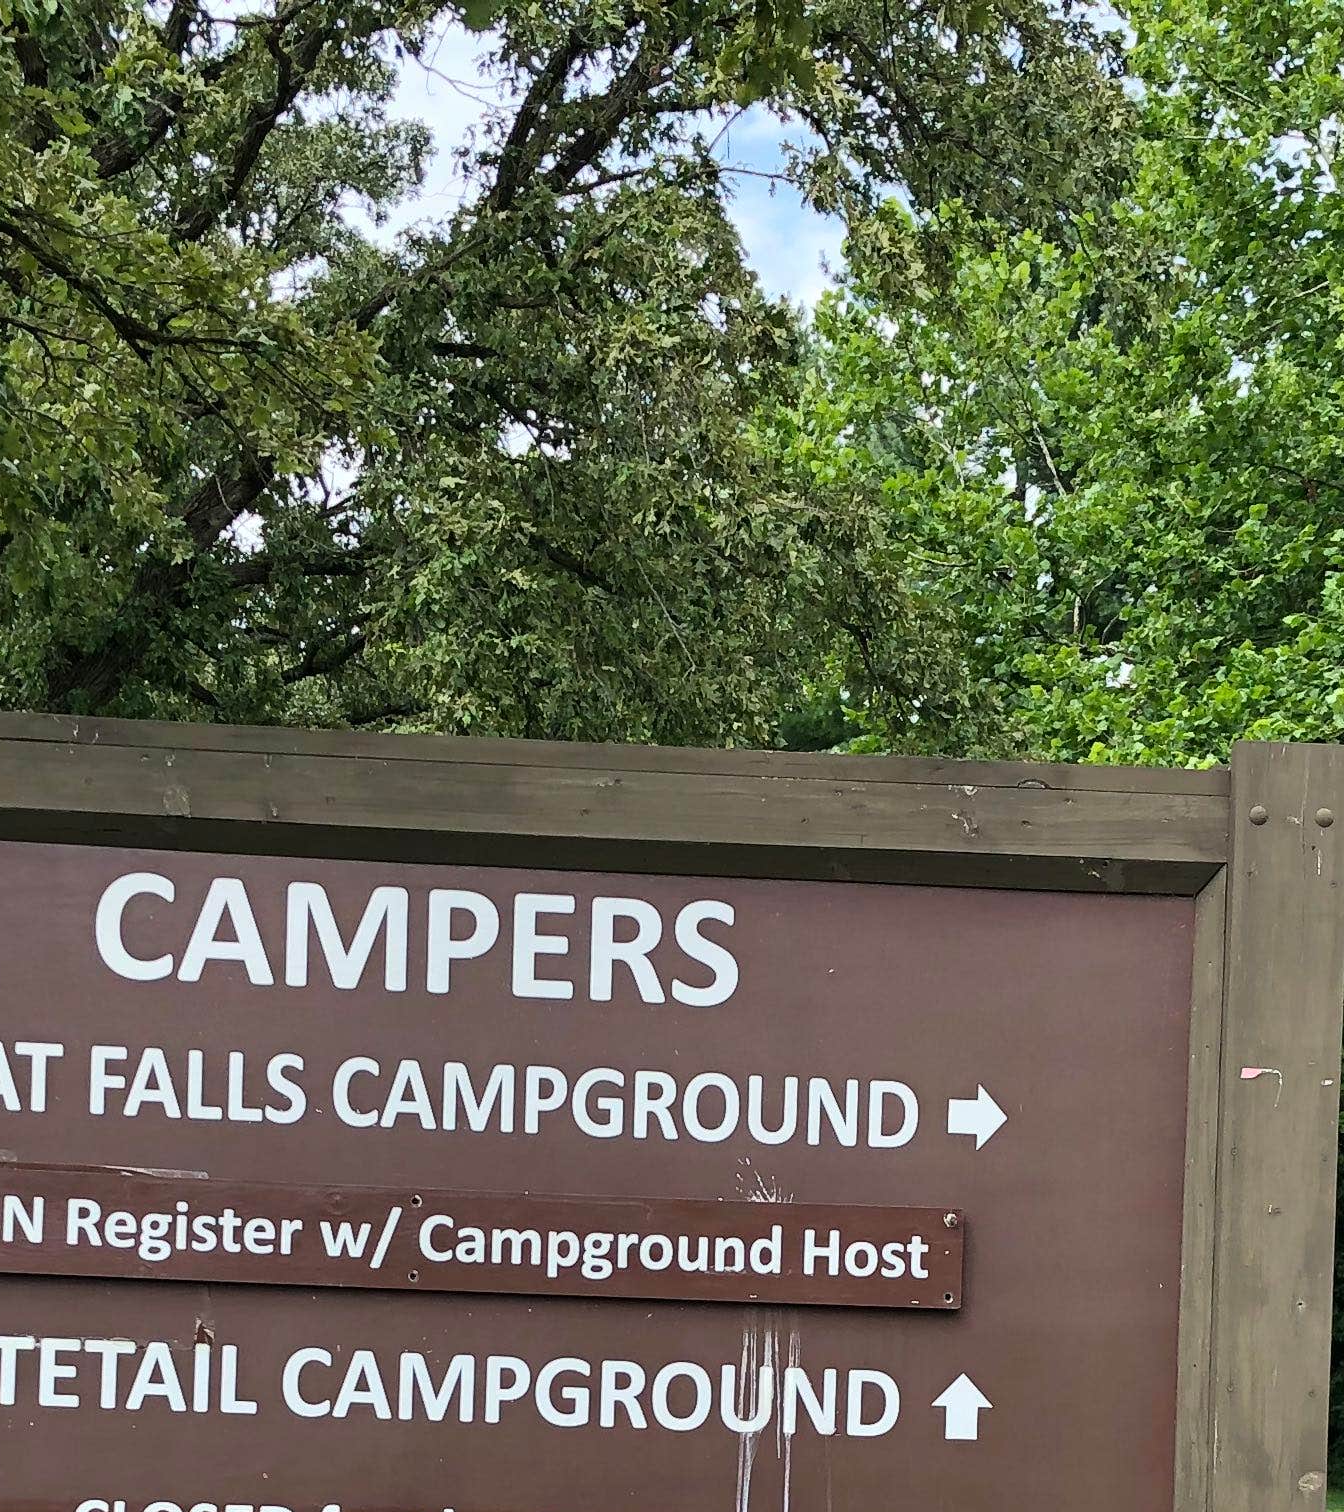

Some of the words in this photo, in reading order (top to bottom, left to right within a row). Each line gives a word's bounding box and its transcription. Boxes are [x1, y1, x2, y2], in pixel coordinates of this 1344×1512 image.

[96, 873, 738, 1006] CAMPERS
[90, 1046, 306, 1123] FALLS
[333, 1057, 918, 1147] CAMPGROUND
[67, 1199, 302, 1261] Register
[320, 1207, 402, 1268] w/
[419, 1215, 782, 1279] Campground
[804, 1230, 928, 1278] Host
[281, 1347, 900, 1437] CAMPGROUND
